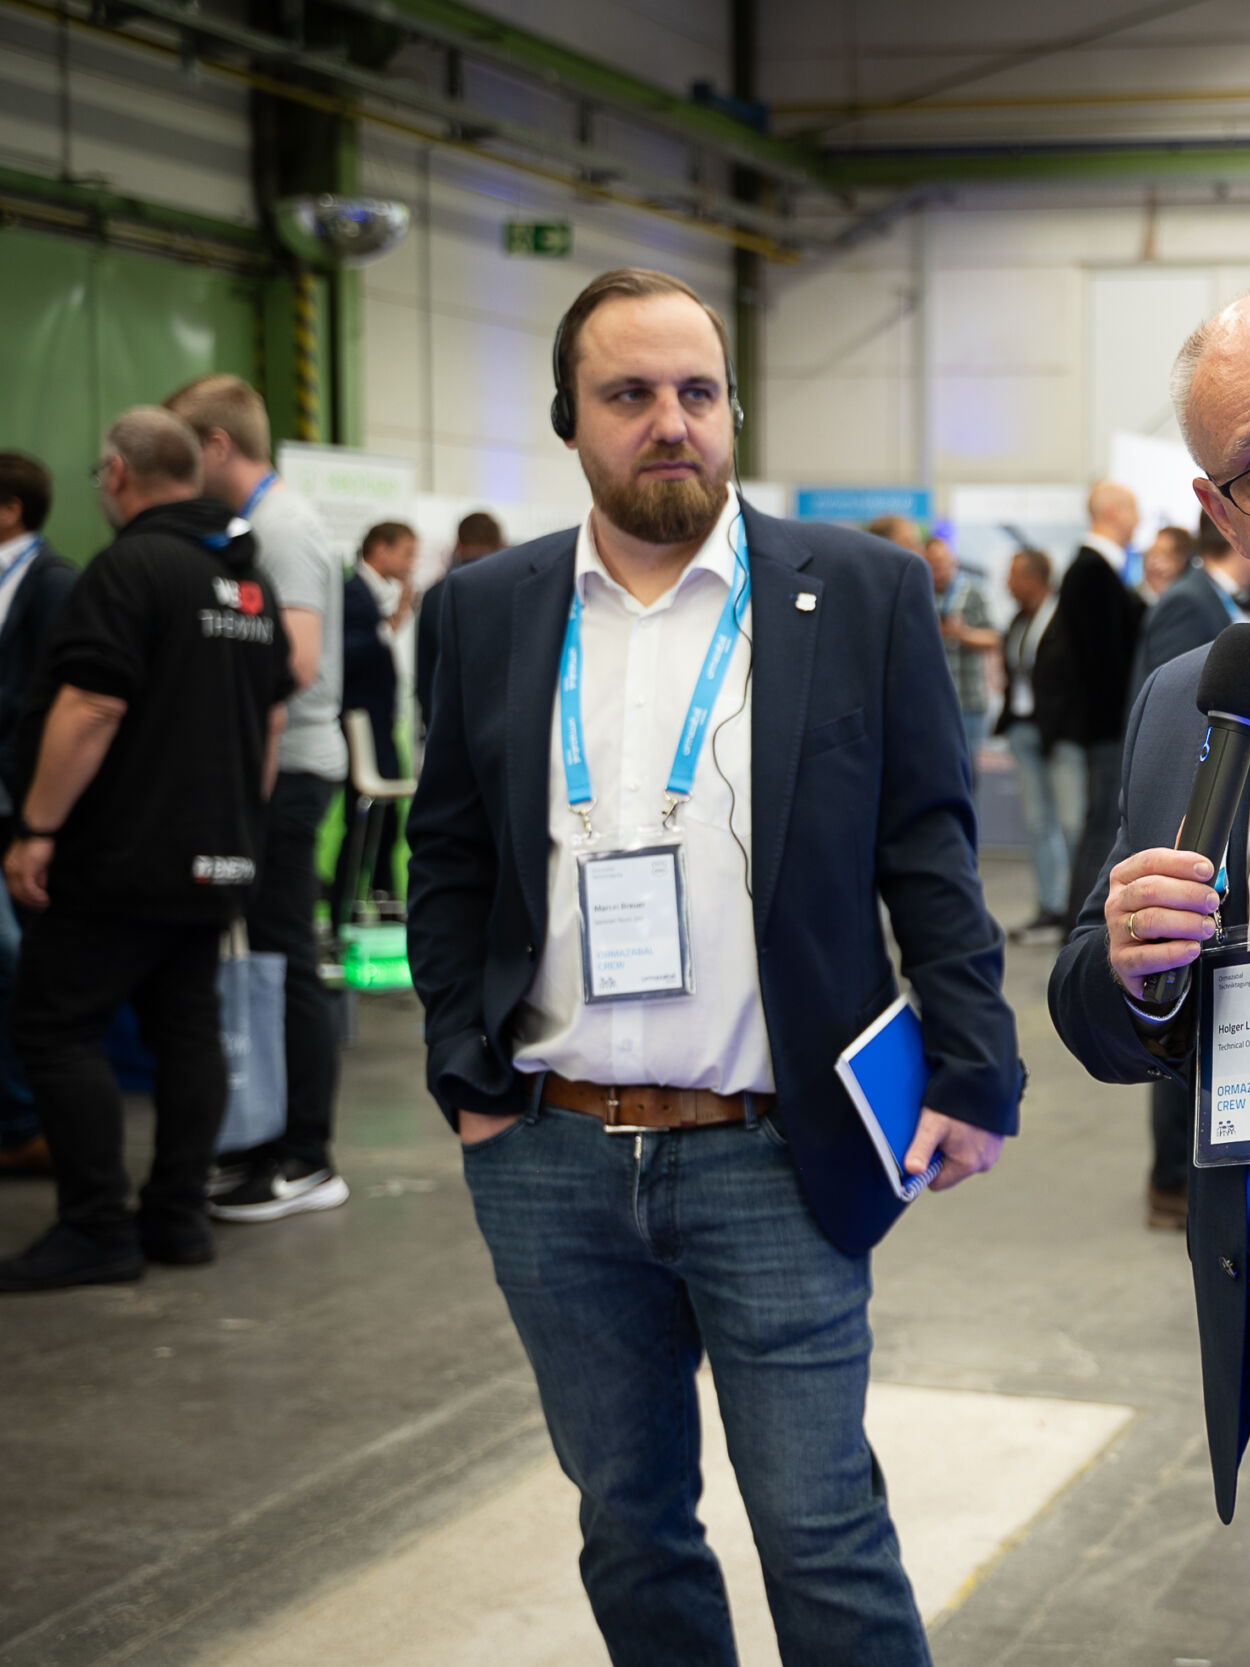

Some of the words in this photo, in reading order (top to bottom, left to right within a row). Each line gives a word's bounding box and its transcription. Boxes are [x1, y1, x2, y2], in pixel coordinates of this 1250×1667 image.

[1218, 1022, 1244, 1035] Holger
[1217, 1040, 1245, 1052] Technical
[1217, 1098, 1247, 1112] CREW
